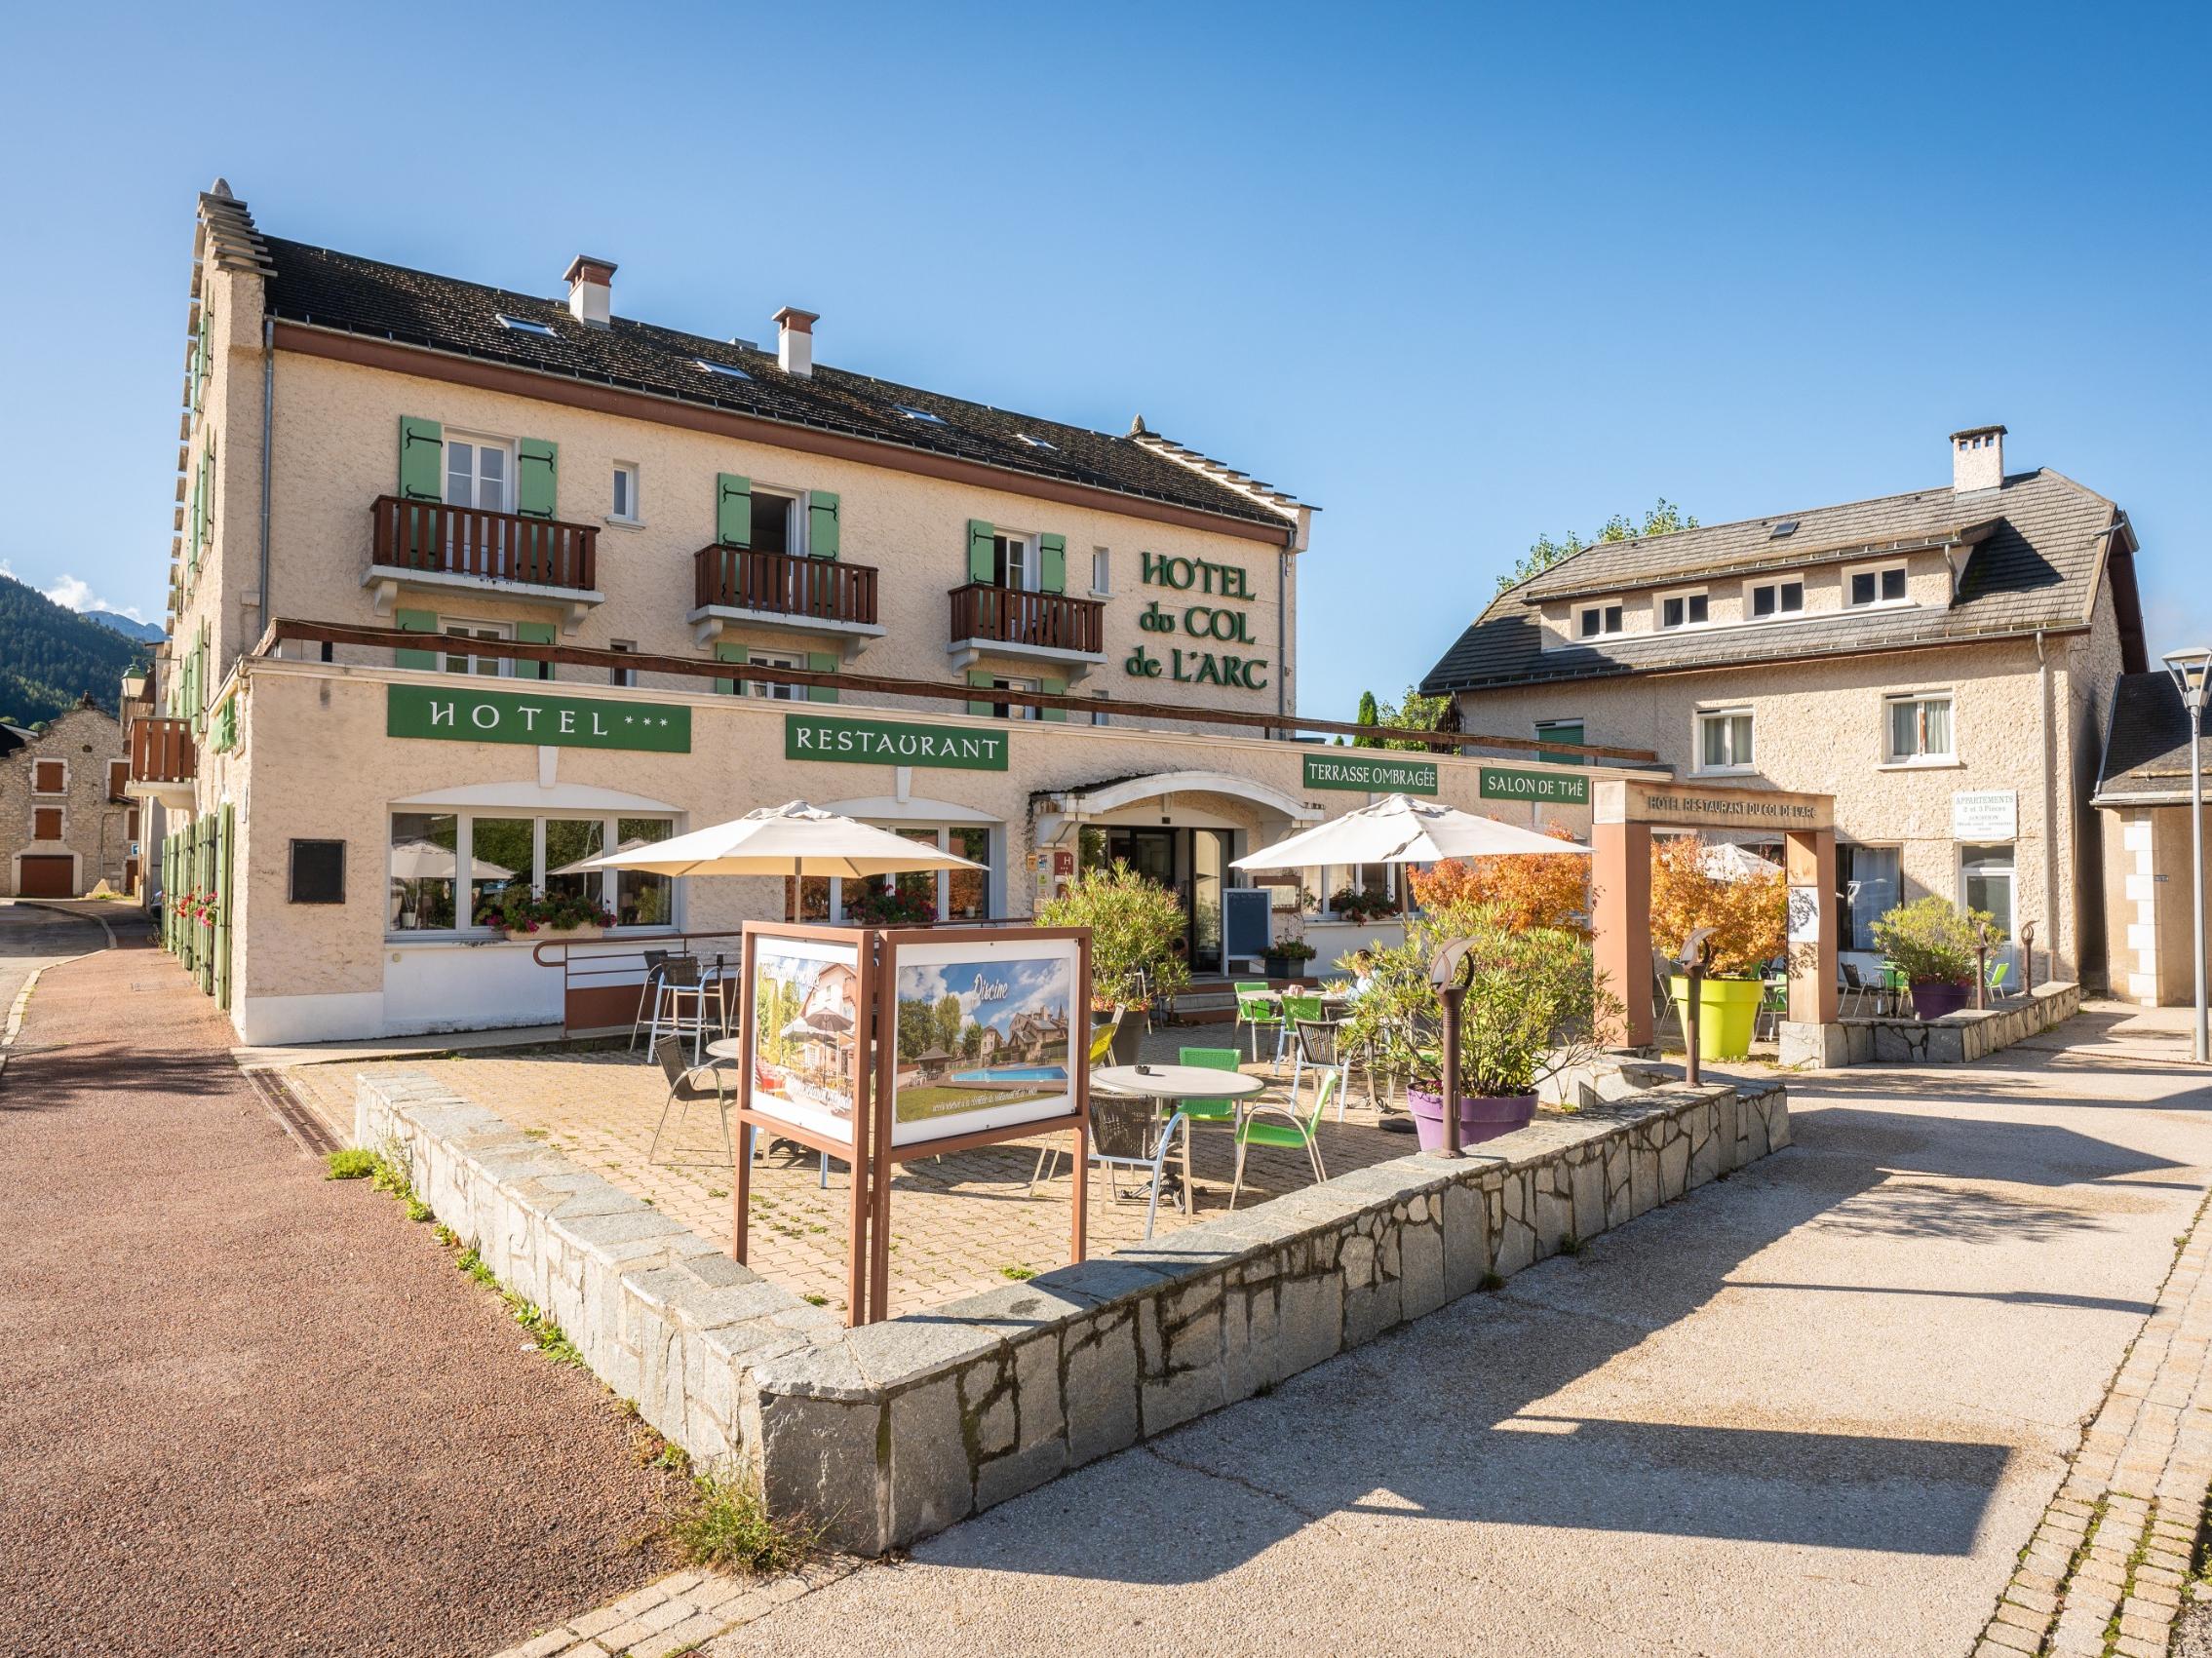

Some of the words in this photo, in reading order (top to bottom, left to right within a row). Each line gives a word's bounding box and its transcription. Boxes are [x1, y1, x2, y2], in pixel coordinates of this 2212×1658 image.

[1142, 552, 1256, 601] HOTEL
[1140, 600, 1176, 633] du
[1184, 606, 1256, 644] COL
[1126, 645, 1162, 677] de
[1172, 648, 1269, 690] L'ARC
[429, 701, 609, 736] HOTEL
[796, 727, 1000, 759] RESTAURANT
[1308, 762, 1370, 783] TERRASSE
[1372, 767, 1436, 787] OMBRAGÉE
[1488, 776, 1535, 793] SALON
[1538, 780, 1555, 794] DE
[1558, 779, 1584, 796] THÉ
[1684, 797, 1747, 816] RESTAURANT
[1748, 803, 1762, 816] DU
[1763, 804, 1780, 817] COL
[1781, 805, 1794, 818] DE
[1956, 795, 2013, 804] APPARTEMENTS
[1064, 856, 1071, 866] H
[974, 973, 1008, 1002] Piscine
